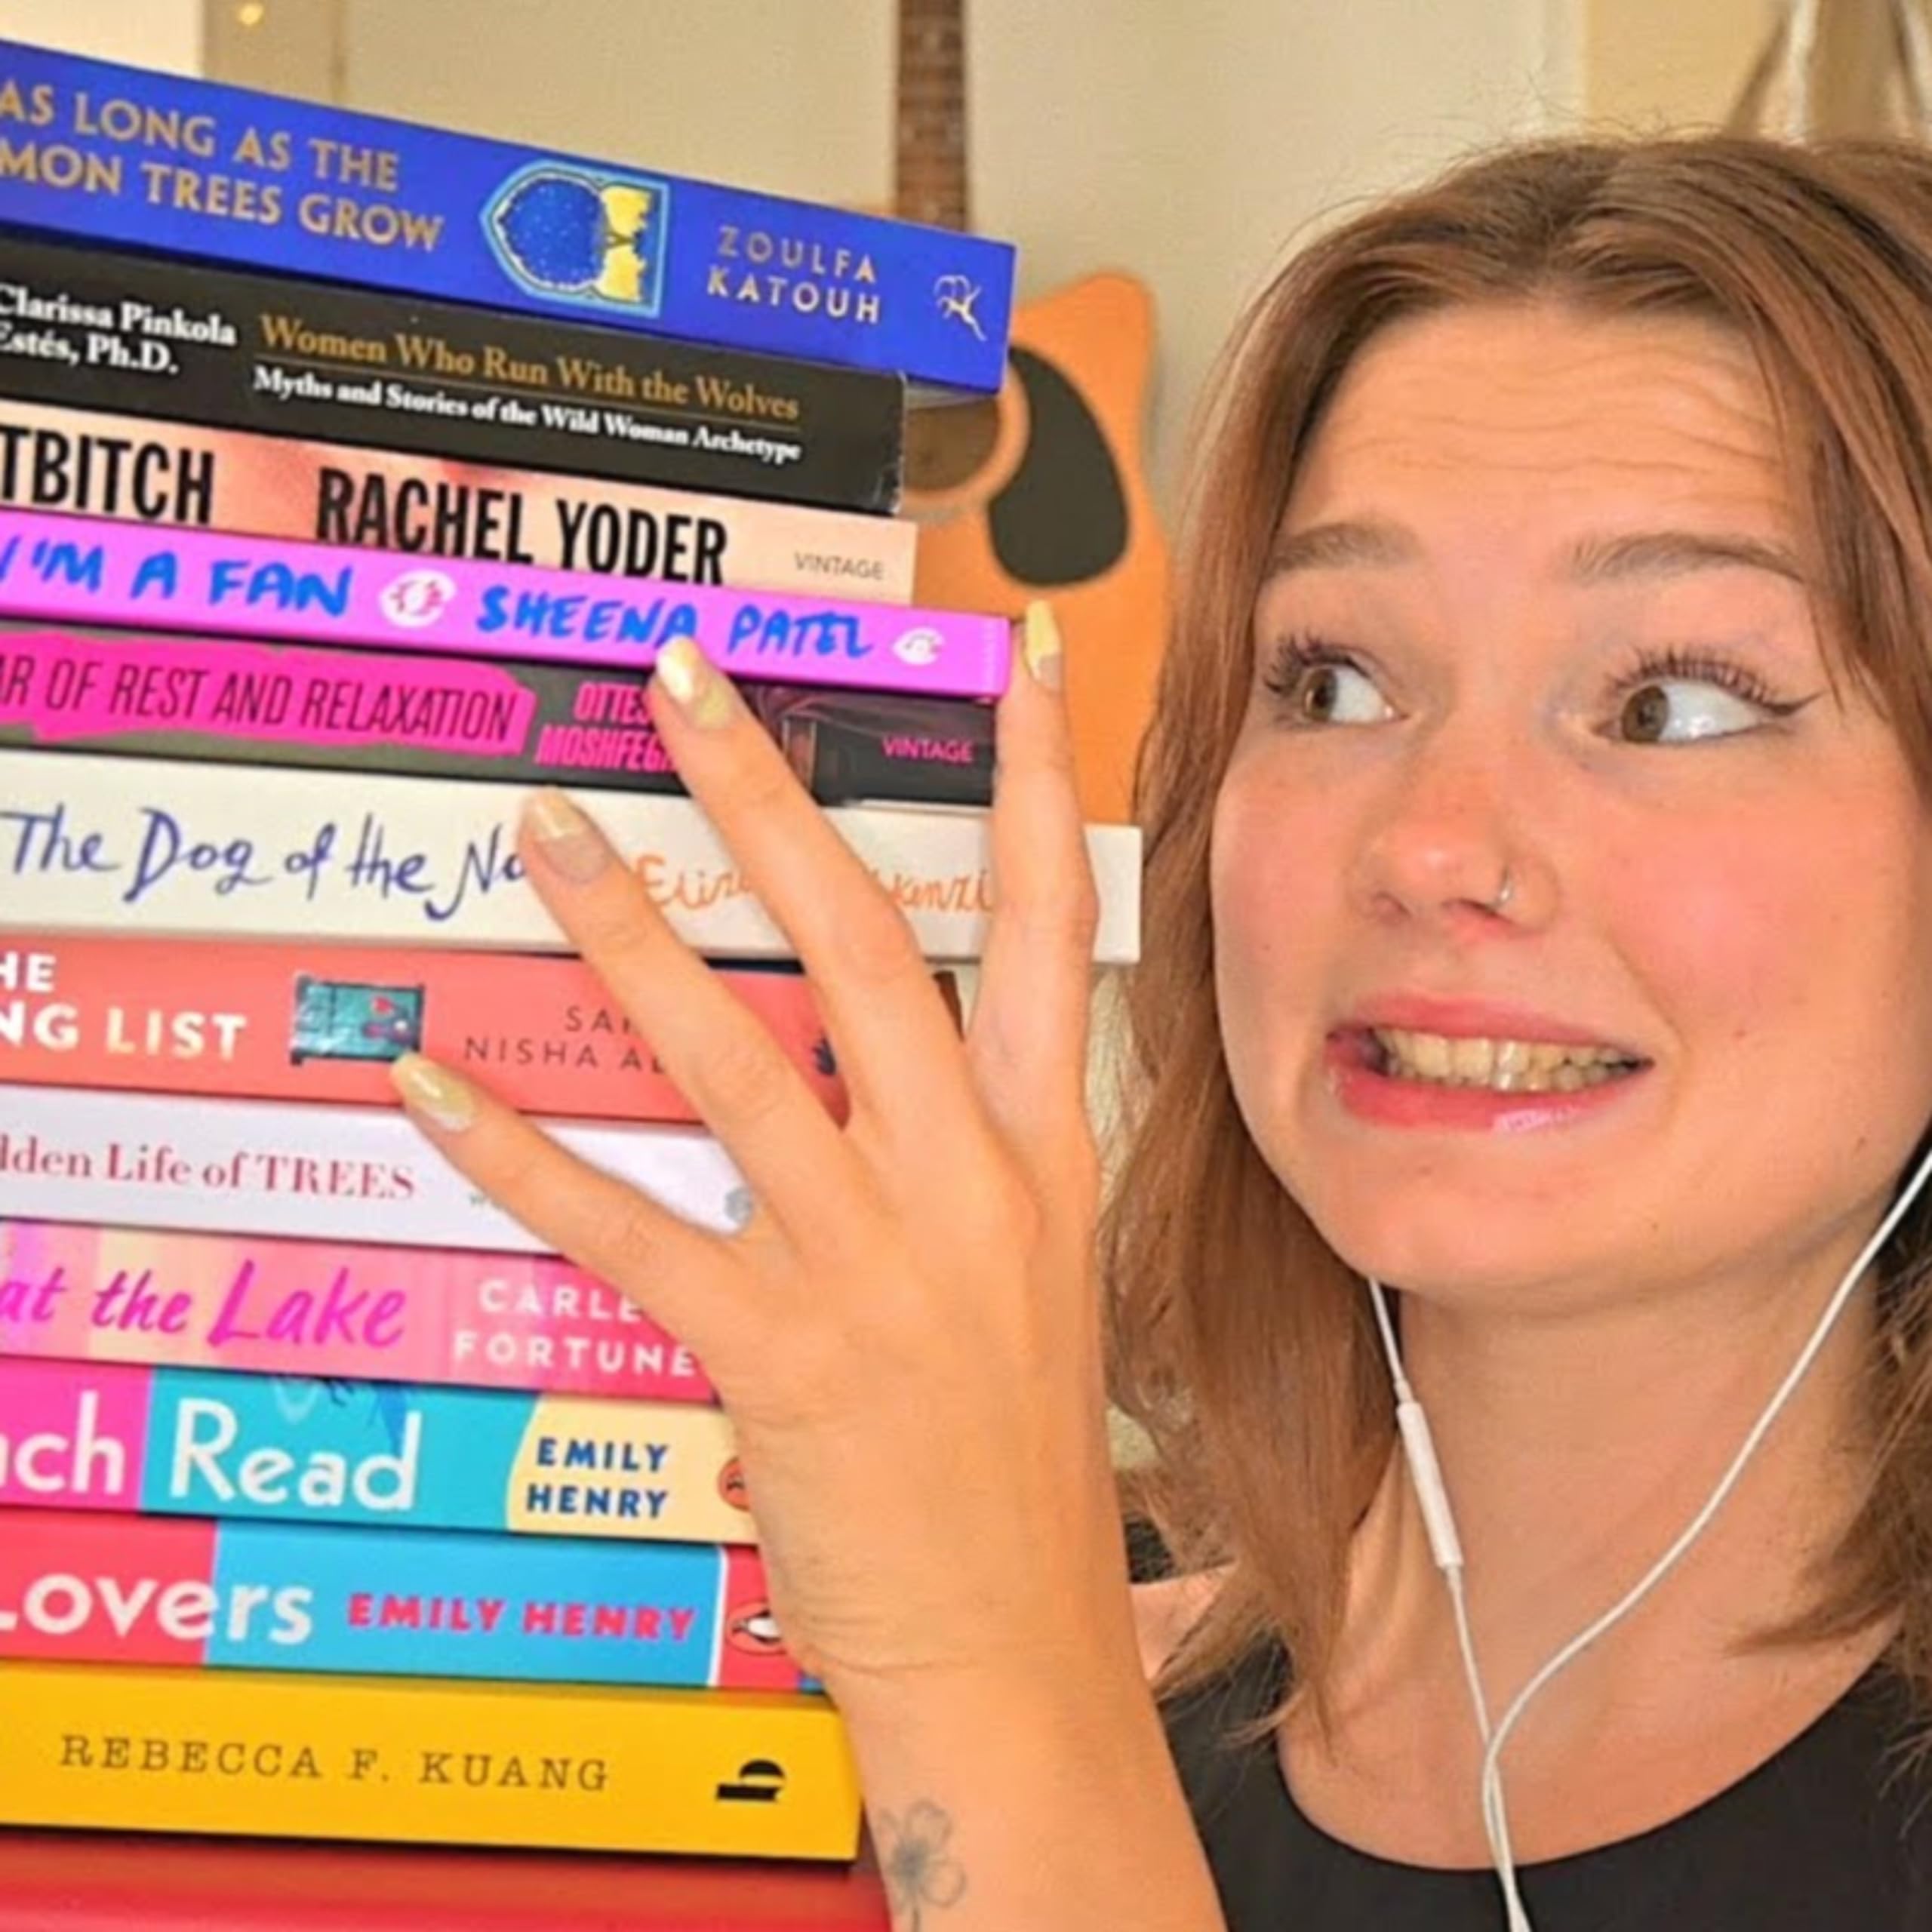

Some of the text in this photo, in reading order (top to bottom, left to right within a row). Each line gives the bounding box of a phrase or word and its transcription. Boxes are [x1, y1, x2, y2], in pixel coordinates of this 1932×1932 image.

[0, 78, 400, 192] AS LONG AS THE
[0, 137, 445, 253] MON TREES GROW
[718, 226, 878, 284] ZOULFA
[0, 282, 237, 346] Clarissa Pinkola
[706, 266, 881, 325] KATOUH
[86, 332, 179, 374] Ph.D.
[260, 313, 801, 422] Women Who Run With the Wolves
[252, 366, 802, 465] Myths and Stories of the Wild Woman Archetype
[0, 425, 215, 525] TBITCH
[315, 466, 729, 586] RACHEL YODER
[129, 550, 179, 600] A
[208, 558, 353, 619] FAN
[795, 551, 884, 581] VINTAGE
[475, 584, 874, 658] SHEENA PATEL
[0, 654, 518, 743] R OF REST AND RELAXATION
[534, 723, 674, 772] MOSHFEG
[882, 736, 974, 764] VINTAGE
[0, 802, 527, 923] The Dog of the No
[106, 1008, 248, 1061] LIST
[464, 1035, 598, 1069] NISHA
[106, 1142, 192, 1185] Life
[202, 1149, 248, 1188] of
[251, 1153, 416, 1201] TREES
[0, 1259, 408, 1349] at the Lake
[478, 1279, 641, 1322] CARLE
[454, 1331, 697, 1377] FORTUNE
[0, 1389, 423, 1512] ch Read
[537, 1435, 670, 1474] EMILY
[526, 1481, 670, 1520] HENRY
[346, 1592, 697, 1641] EMILY HENRY
[60, 1733, 611, 1794] REBECCA F. KUANG
